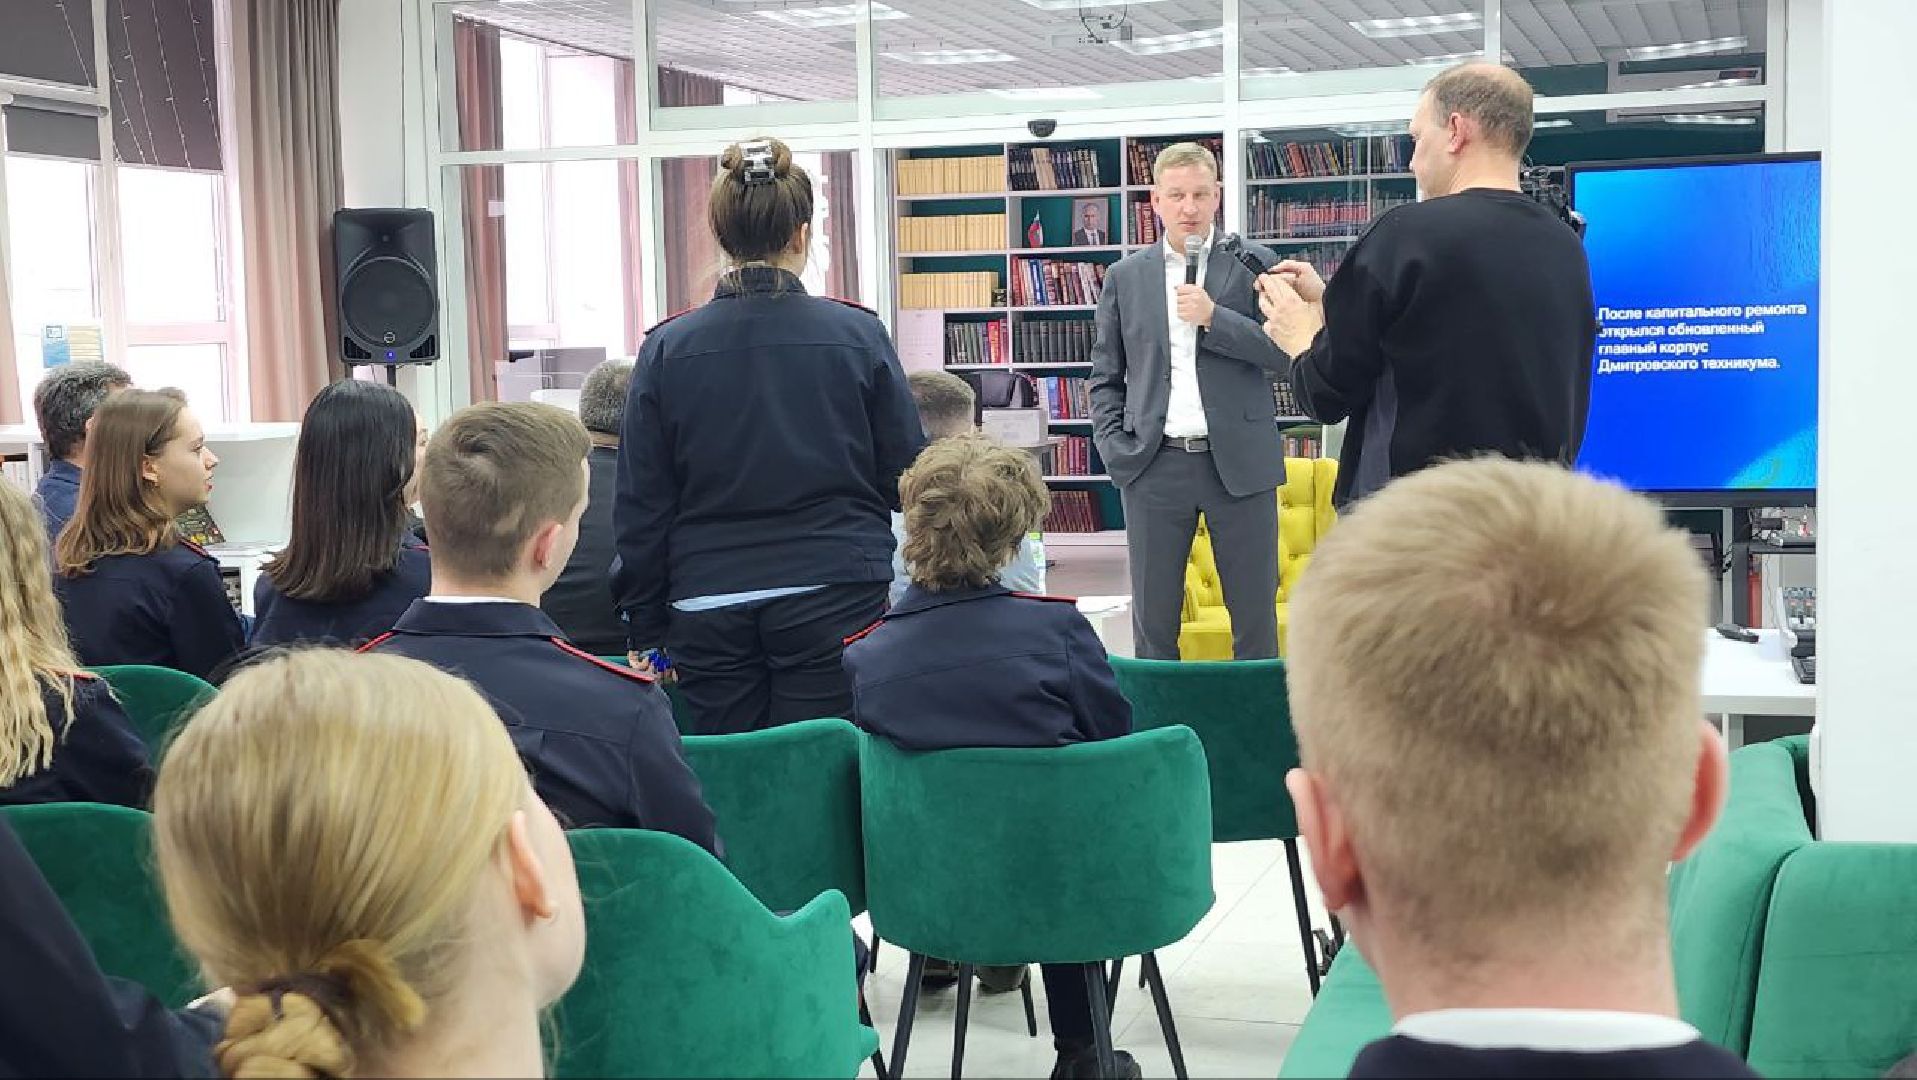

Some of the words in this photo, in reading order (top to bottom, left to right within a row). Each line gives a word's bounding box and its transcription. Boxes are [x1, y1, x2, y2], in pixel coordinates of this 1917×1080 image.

[1598, 307, 1642, 321] После
[1646, 306, 1742, 319] капитального
[1745, 303, 1807, 318] ремонта
[1667, 321, 1765, 335] обновленный
[1598, 341, 1656, 355] главный
[1660, 343, 1708, 355] корпус
[1598, 359, 1698, 374] Дмитровского
[1701, 357, 1780, 371] техникума.
